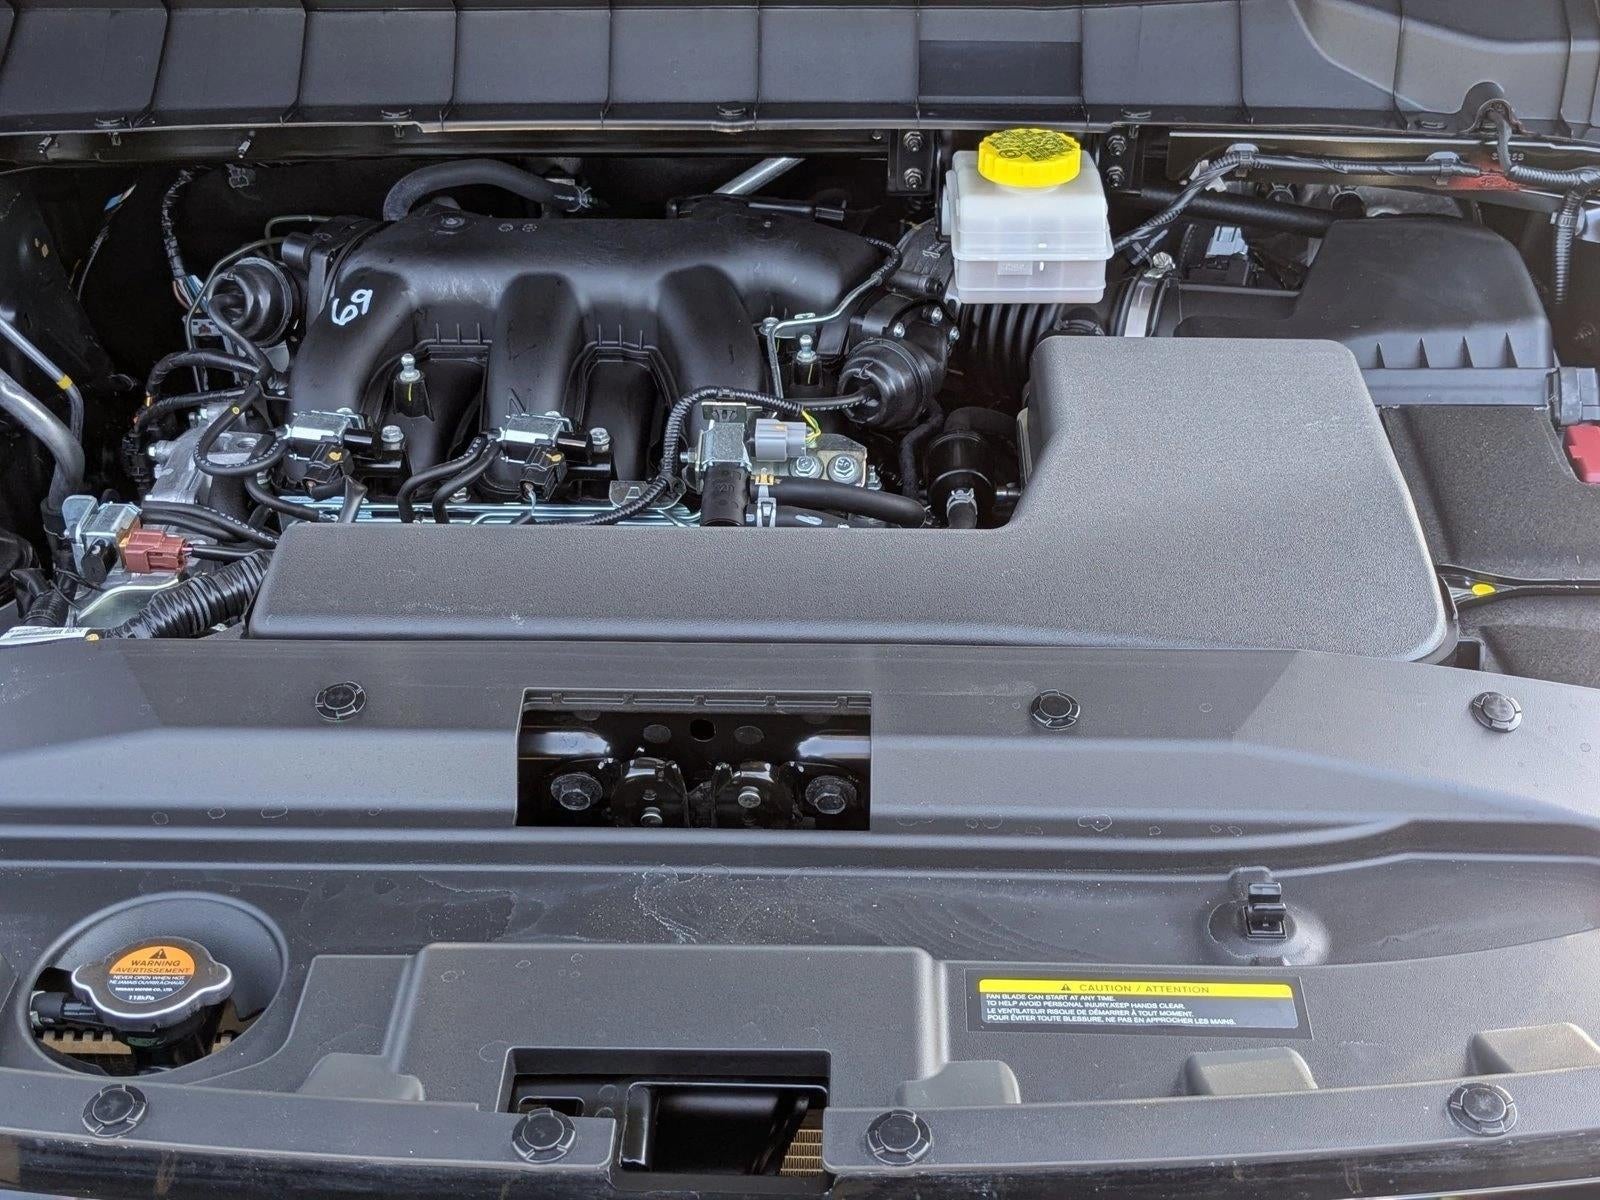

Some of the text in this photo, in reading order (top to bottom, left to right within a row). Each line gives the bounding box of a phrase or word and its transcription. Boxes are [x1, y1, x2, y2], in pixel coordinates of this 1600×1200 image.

[332, 289, 373, 326] 69
[1079, 984, 1132, 992] CAUTION
[1145, 985, 1210, 994] ATTENTION
[1088, 1008, 1130, 1016] DÉMARRER
